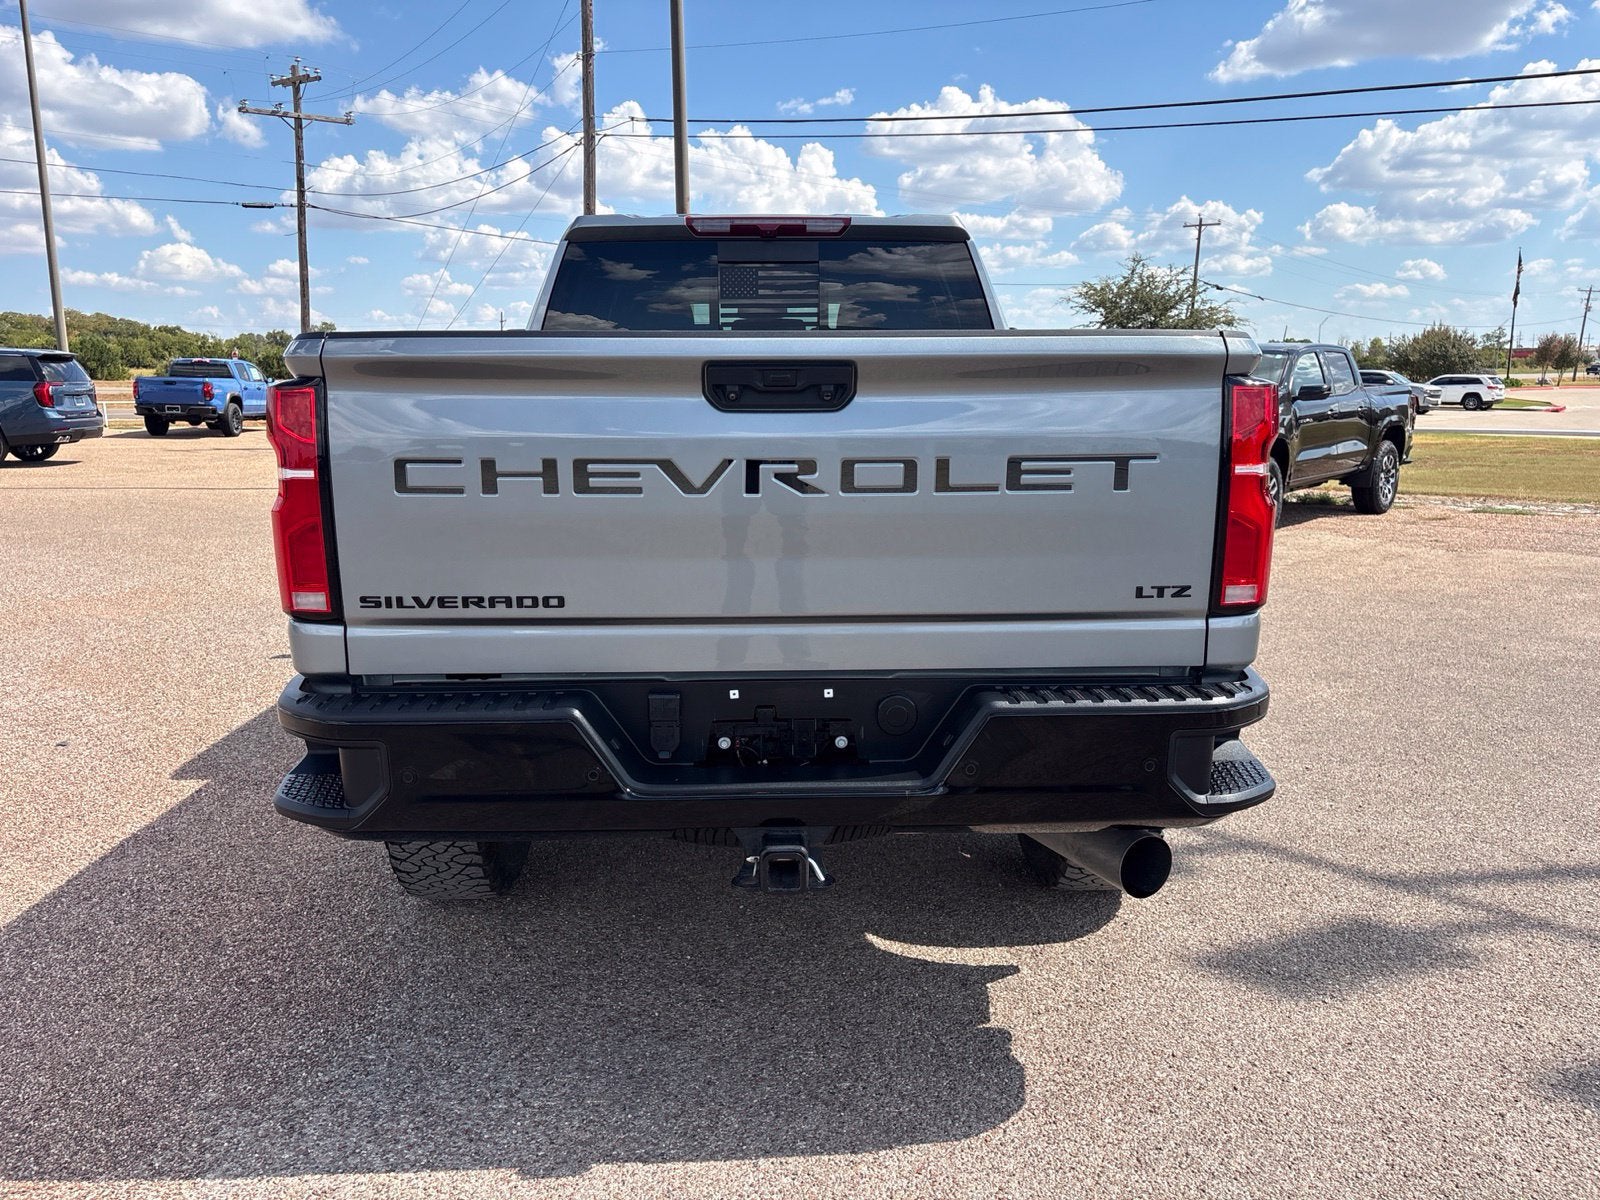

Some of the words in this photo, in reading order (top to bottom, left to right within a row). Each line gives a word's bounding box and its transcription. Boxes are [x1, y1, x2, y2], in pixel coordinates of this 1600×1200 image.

[394, 453, 1160, 498] CHEVROLET
[1135, 585, 1192, 599] LTZ
[359, 595, 566, 609] SILVERADO
